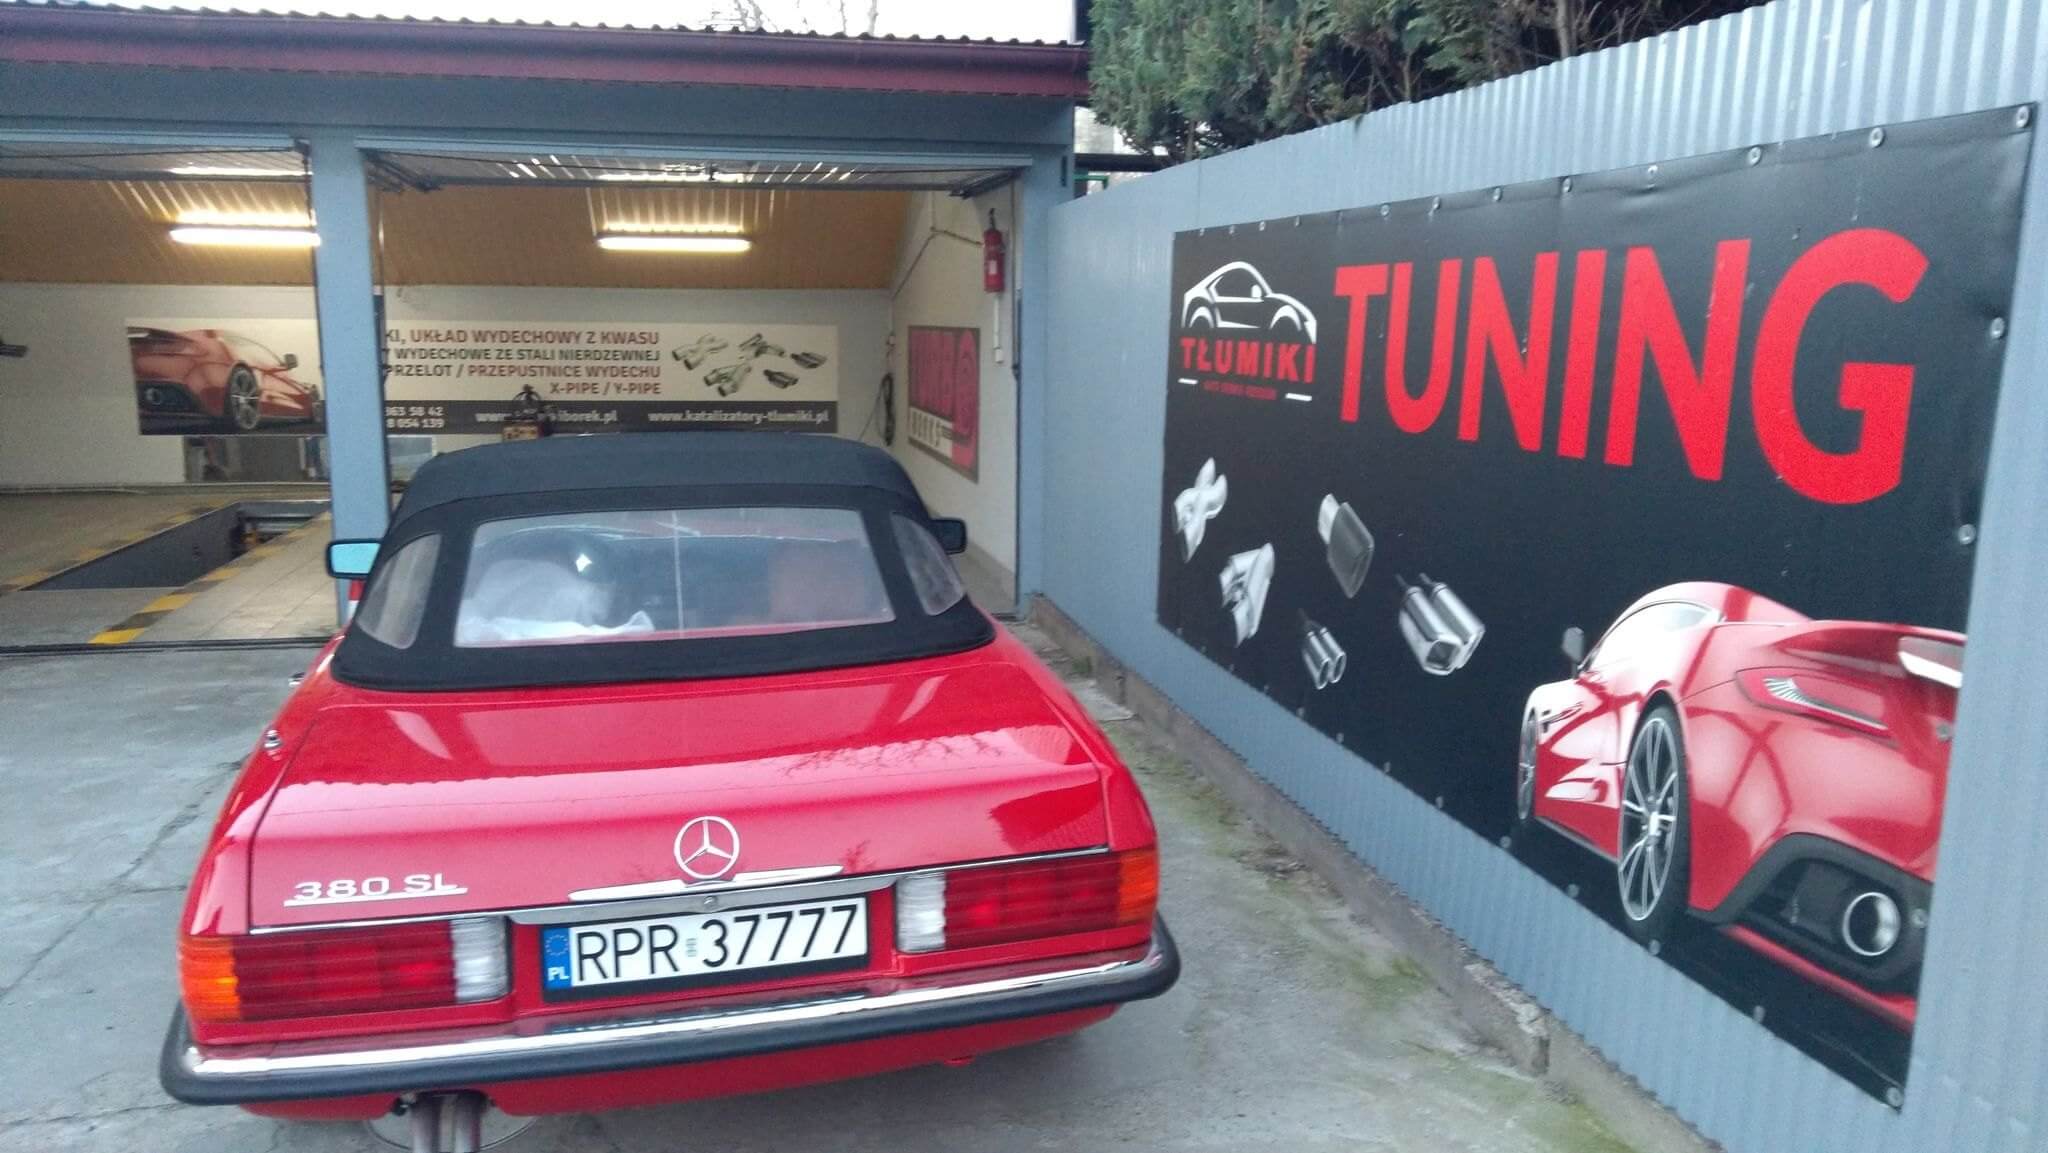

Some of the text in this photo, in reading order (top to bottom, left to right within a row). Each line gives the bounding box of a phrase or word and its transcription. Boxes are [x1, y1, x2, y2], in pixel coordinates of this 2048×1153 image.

[410, 329, 468, 343] UKŁAD
[471, 329, 582, 344] WYDECHOWY
[585, 331, 597, 344] Z
[601, 331, 659, 345] KWASU
[394, 348, 492, 360] WYDECHOWE
[495, 348, 513, 360] ZE
[517, 348, 555, 360] STALI
[559, 349, 660, 361] NIERDZEWNEJ
[1180, 336, 1316, 384] TŁUMIKI
[468, 365, 581, 377] PRZEPUSTNICE
[585, 366, 660, 378] WYDECHU
[1334, 227, 1930, 505] TUNING
[550, 382, 600, 394] X-PIPE
[613, 382, 661, 394] Y-PIPE
[294, 873, 458, 900] 380 SL
[575, 903, 858, 982] RPR 37777
[547, 966, 568, 981] PL
